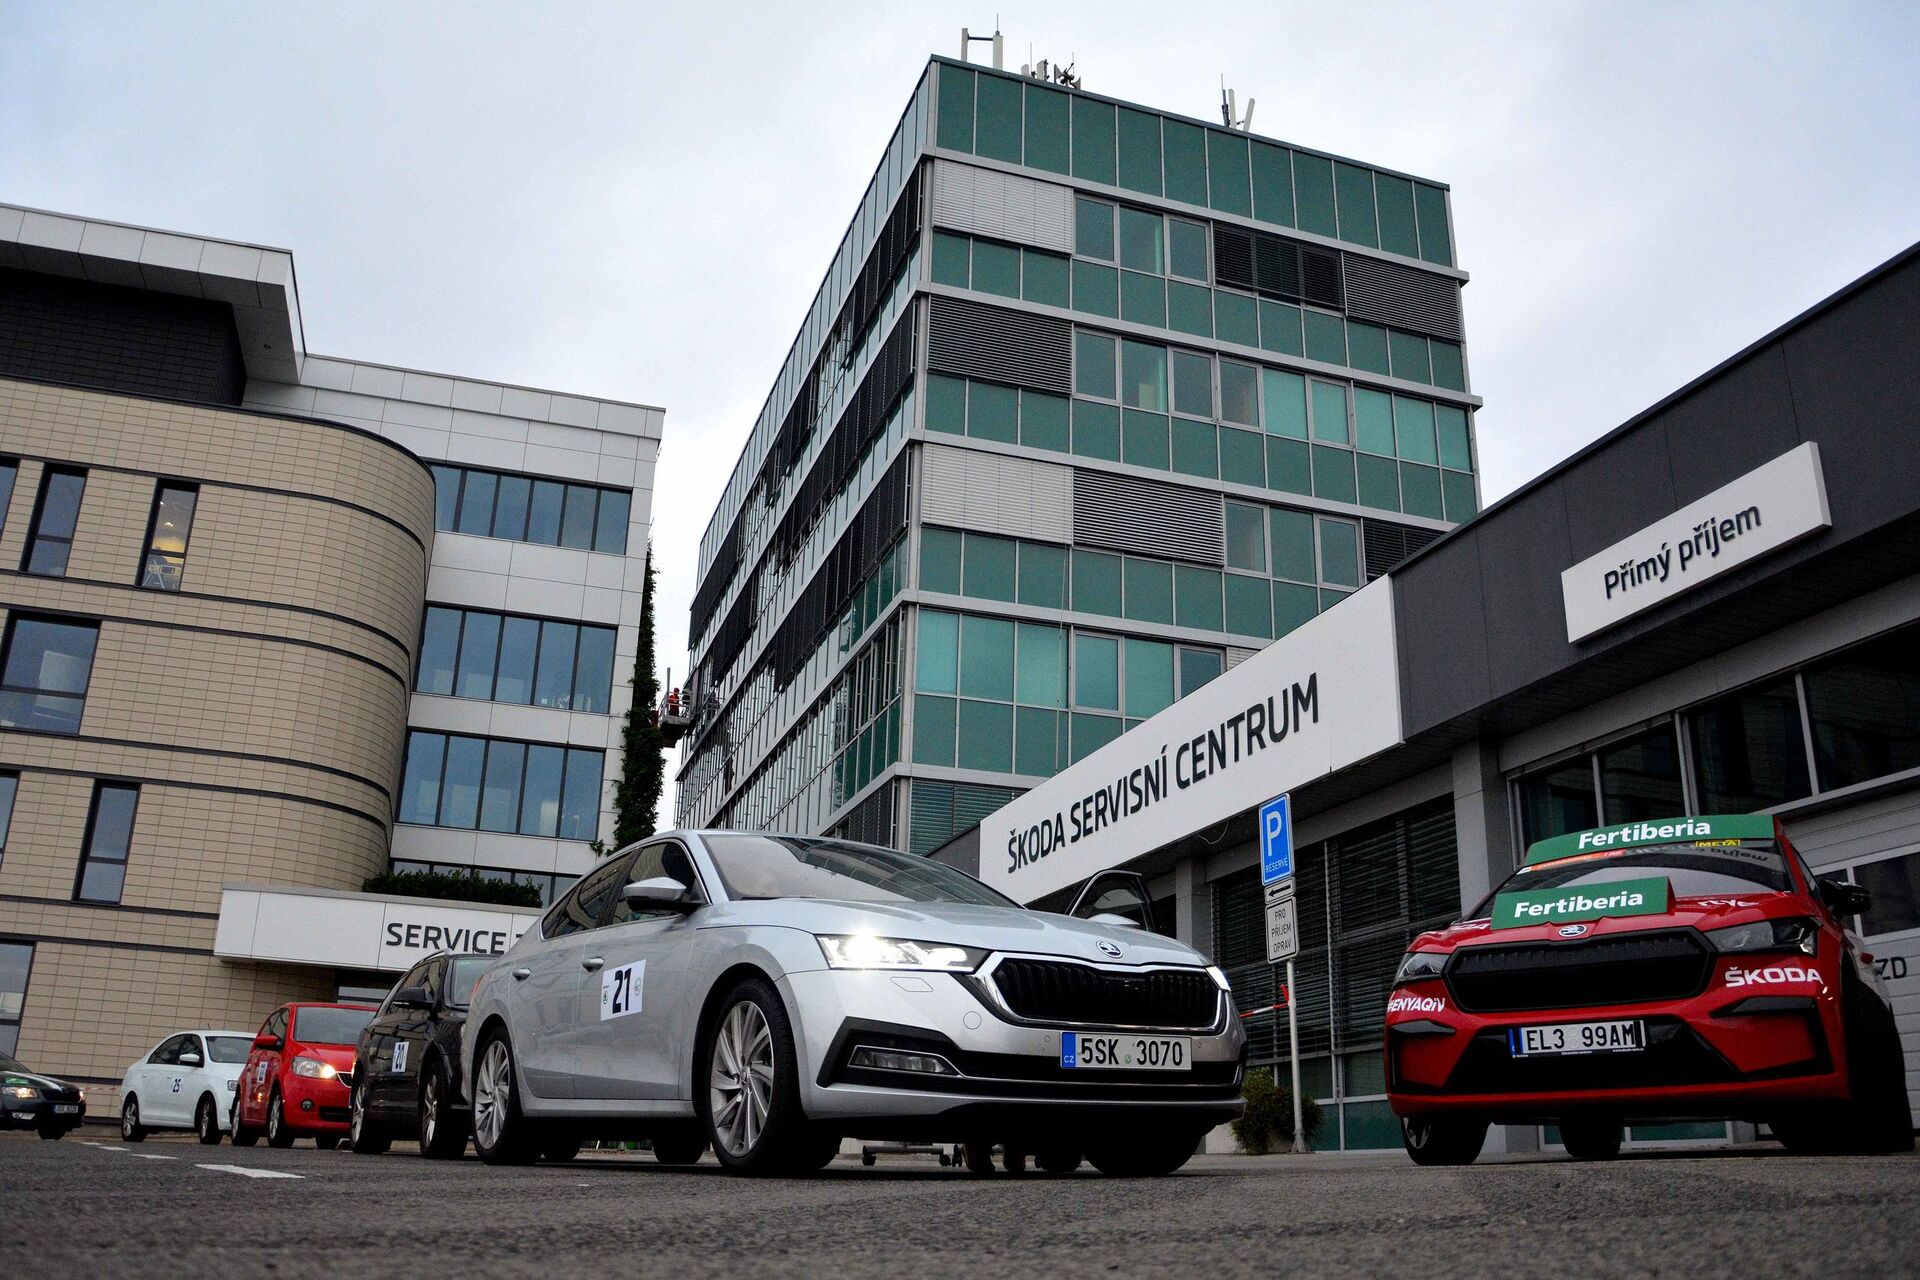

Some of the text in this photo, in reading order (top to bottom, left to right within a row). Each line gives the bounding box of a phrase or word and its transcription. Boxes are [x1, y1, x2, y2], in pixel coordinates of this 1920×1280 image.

[1604, 505, 1762, 599] Přímý příjem
[1007, 672, 1319, 874] ŠKODA SERVISNÍ CENTRUM
[1266, 810, 1282, 857] P
[1578, 819, 1711, 849] Fertiberia
[1274, 908, 1287, 921] PRO
[1514, 890, 1643, 918] Fertiberia
[386, 922, 507, 954] SERVICE
[1273, 938, 1292, 953] OPRAV
[612, 967, 632, 1014] 21
[1725, 966, 1824, 987] ŠKODA
[1081, 1037, 1183, 1066] 5SK 3070
[1526, 1023, 1636, 1051] EL3 99AM
[1063, 1054, 1075, 1064] CZ
